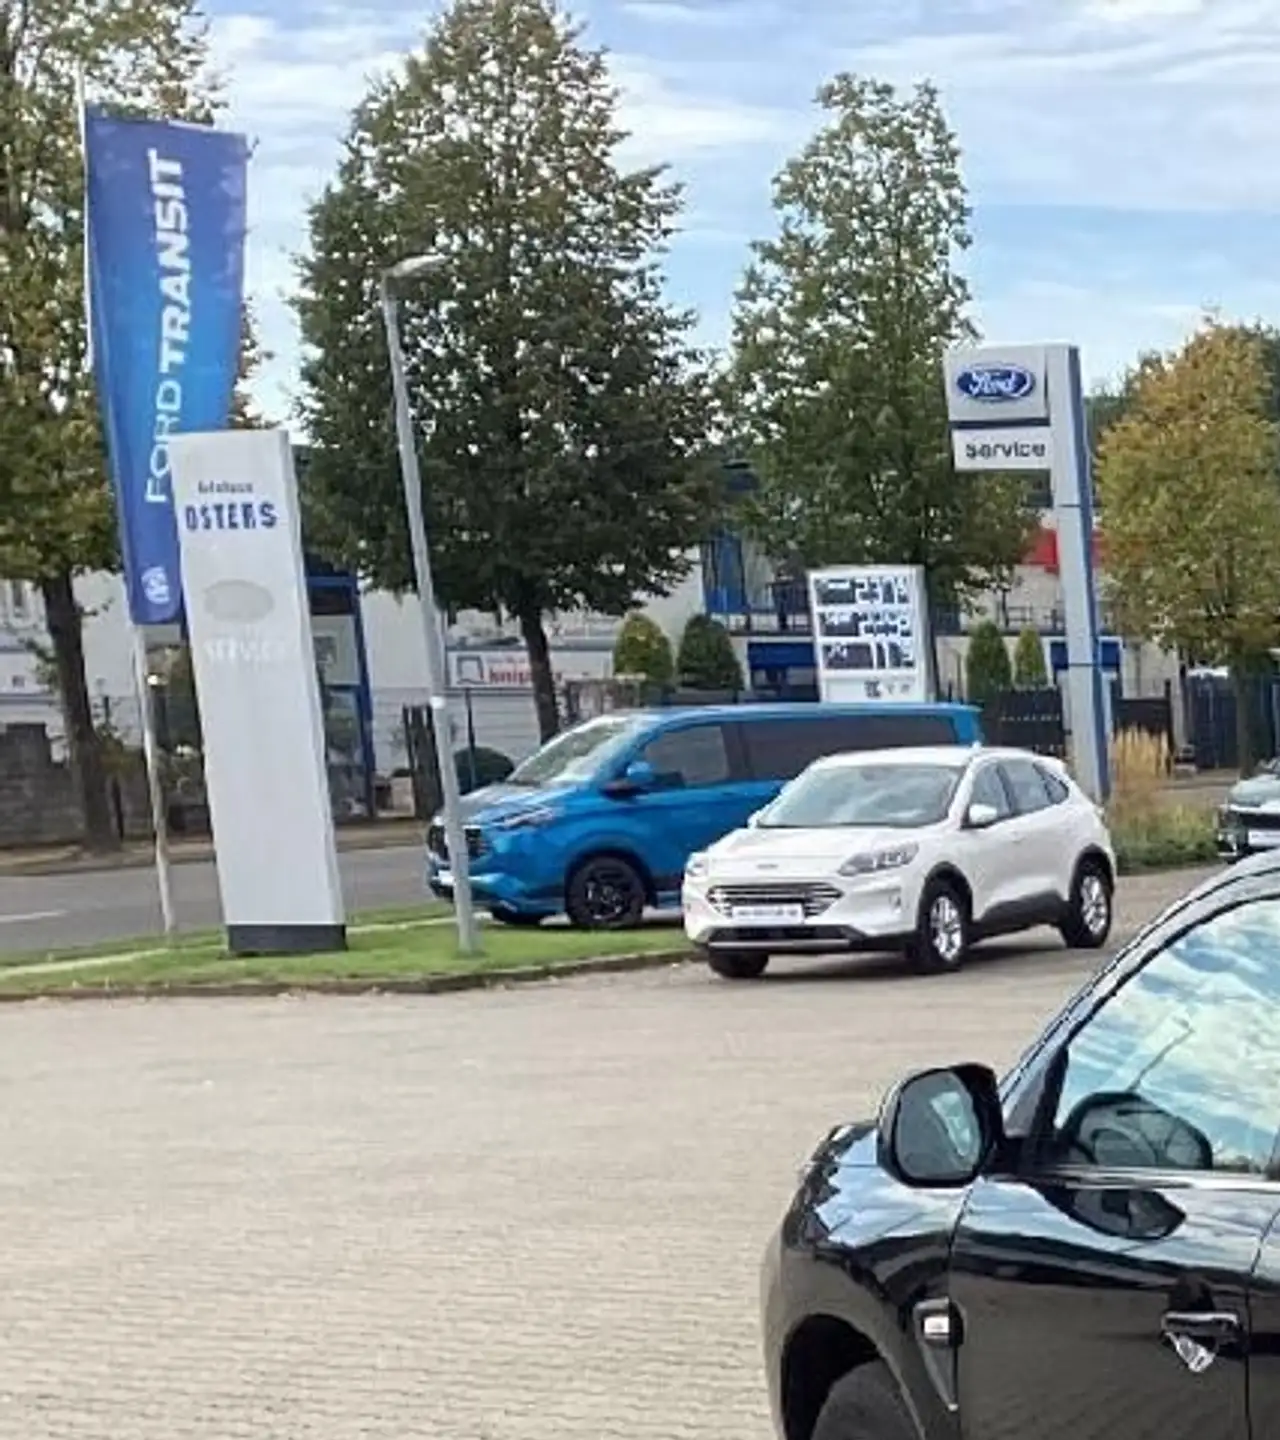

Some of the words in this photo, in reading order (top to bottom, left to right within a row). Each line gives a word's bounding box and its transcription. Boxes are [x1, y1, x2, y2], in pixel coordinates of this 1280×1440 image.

[147, 148, 192, 375] TRANSIT
[967, 369, 1018, 397] Ford
[144, 380, 183, 503] FORD
[965, 441, 1047, 460] Service
[184, 501, 278, 531] OSTERS
